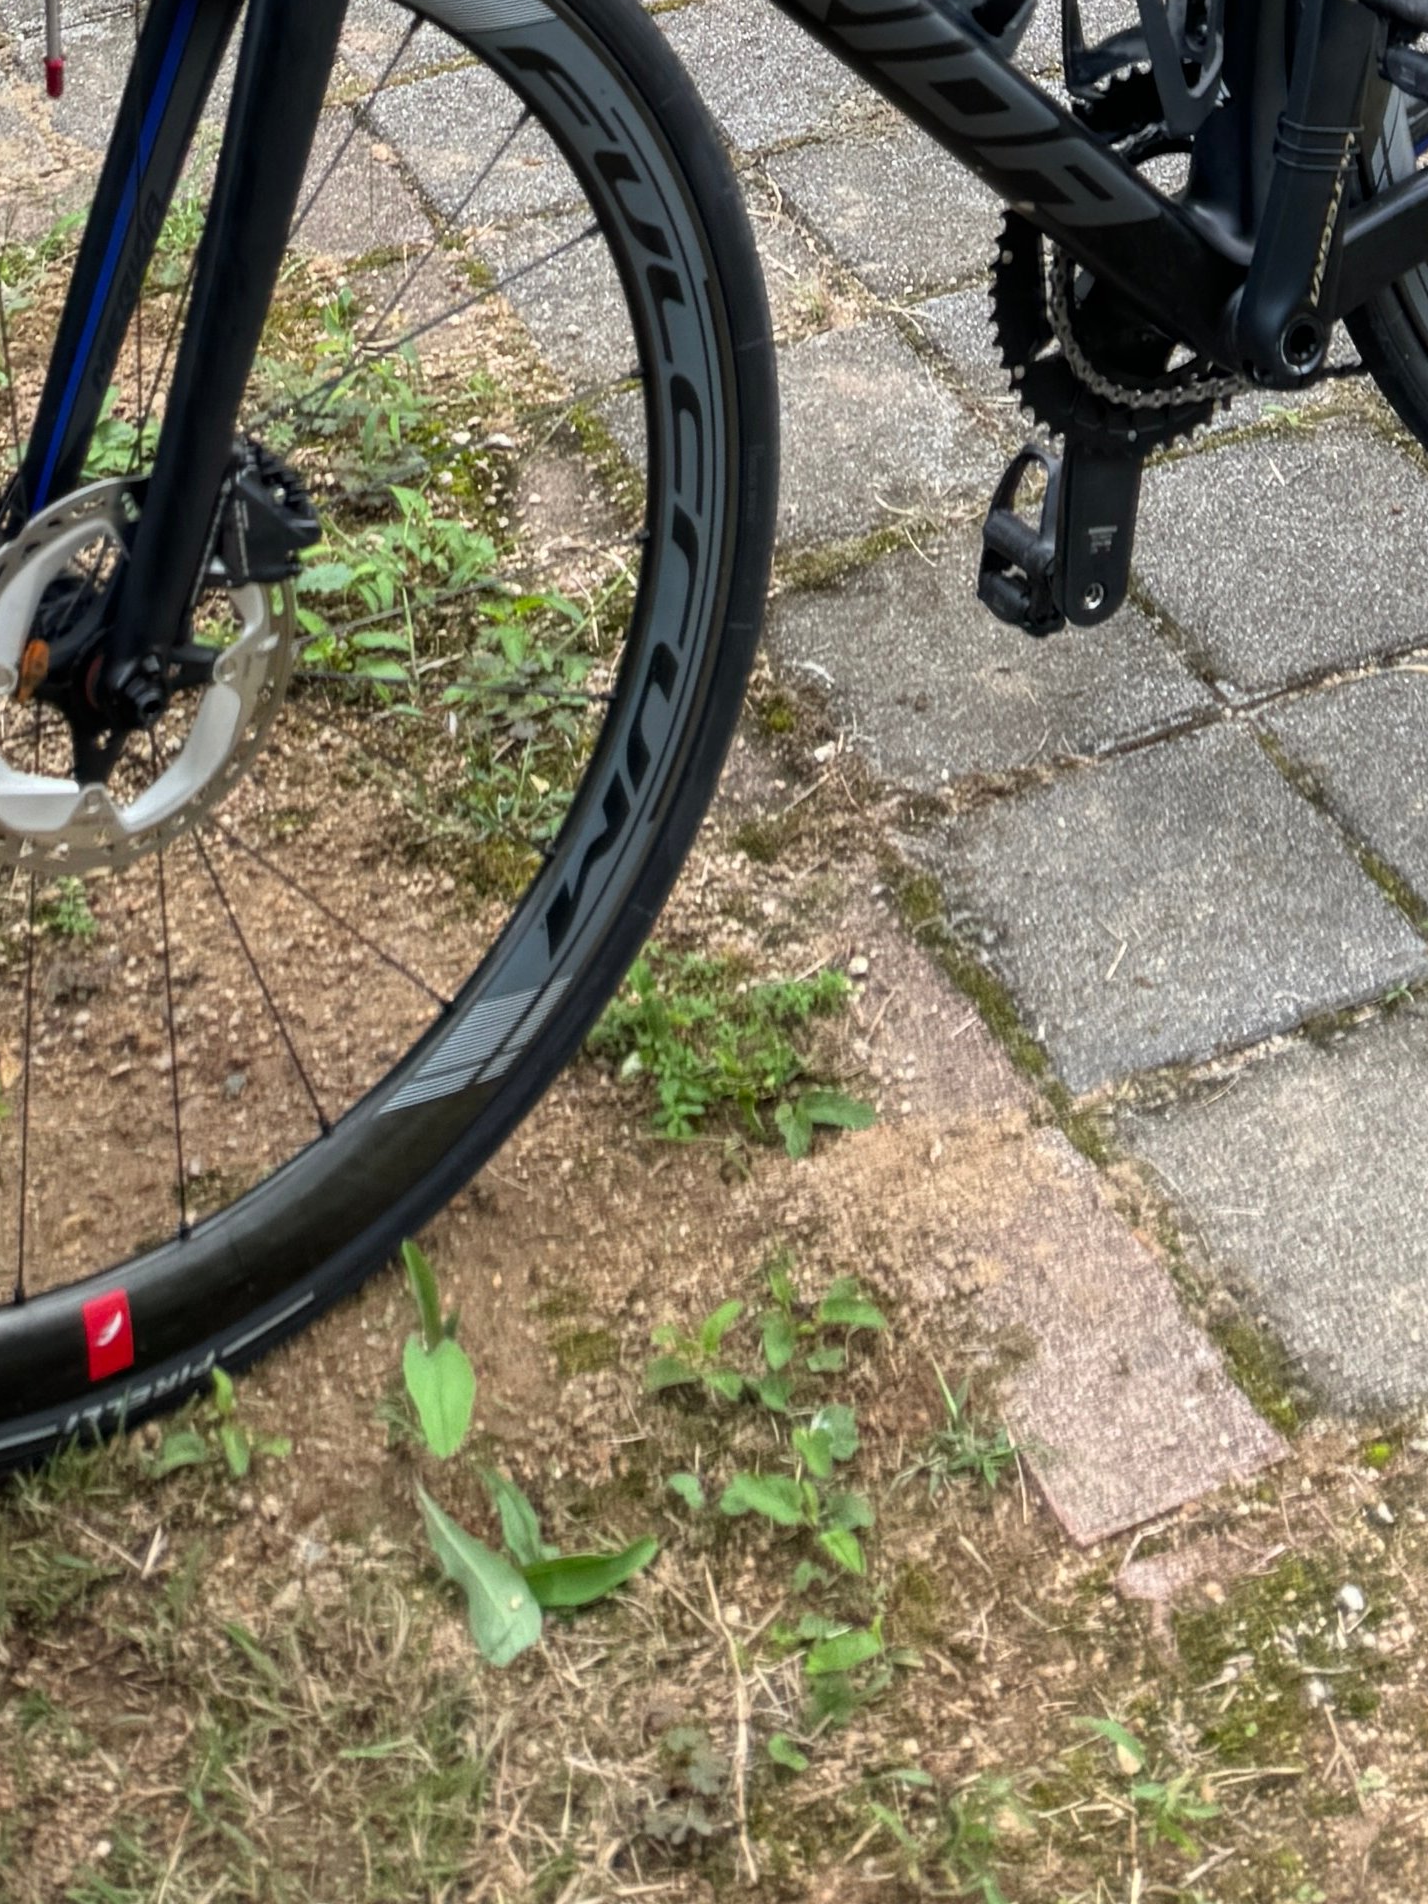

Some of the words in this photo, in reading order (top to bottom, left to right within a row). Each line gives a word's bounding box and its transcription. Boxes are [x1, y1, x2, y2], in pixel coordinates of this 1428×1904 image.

[1309, 131, 1356, 308] ULTEGRA
[496, 42, 704, 962] FULCRUM
[63, 1349, 216, 1435] PIRELLI
